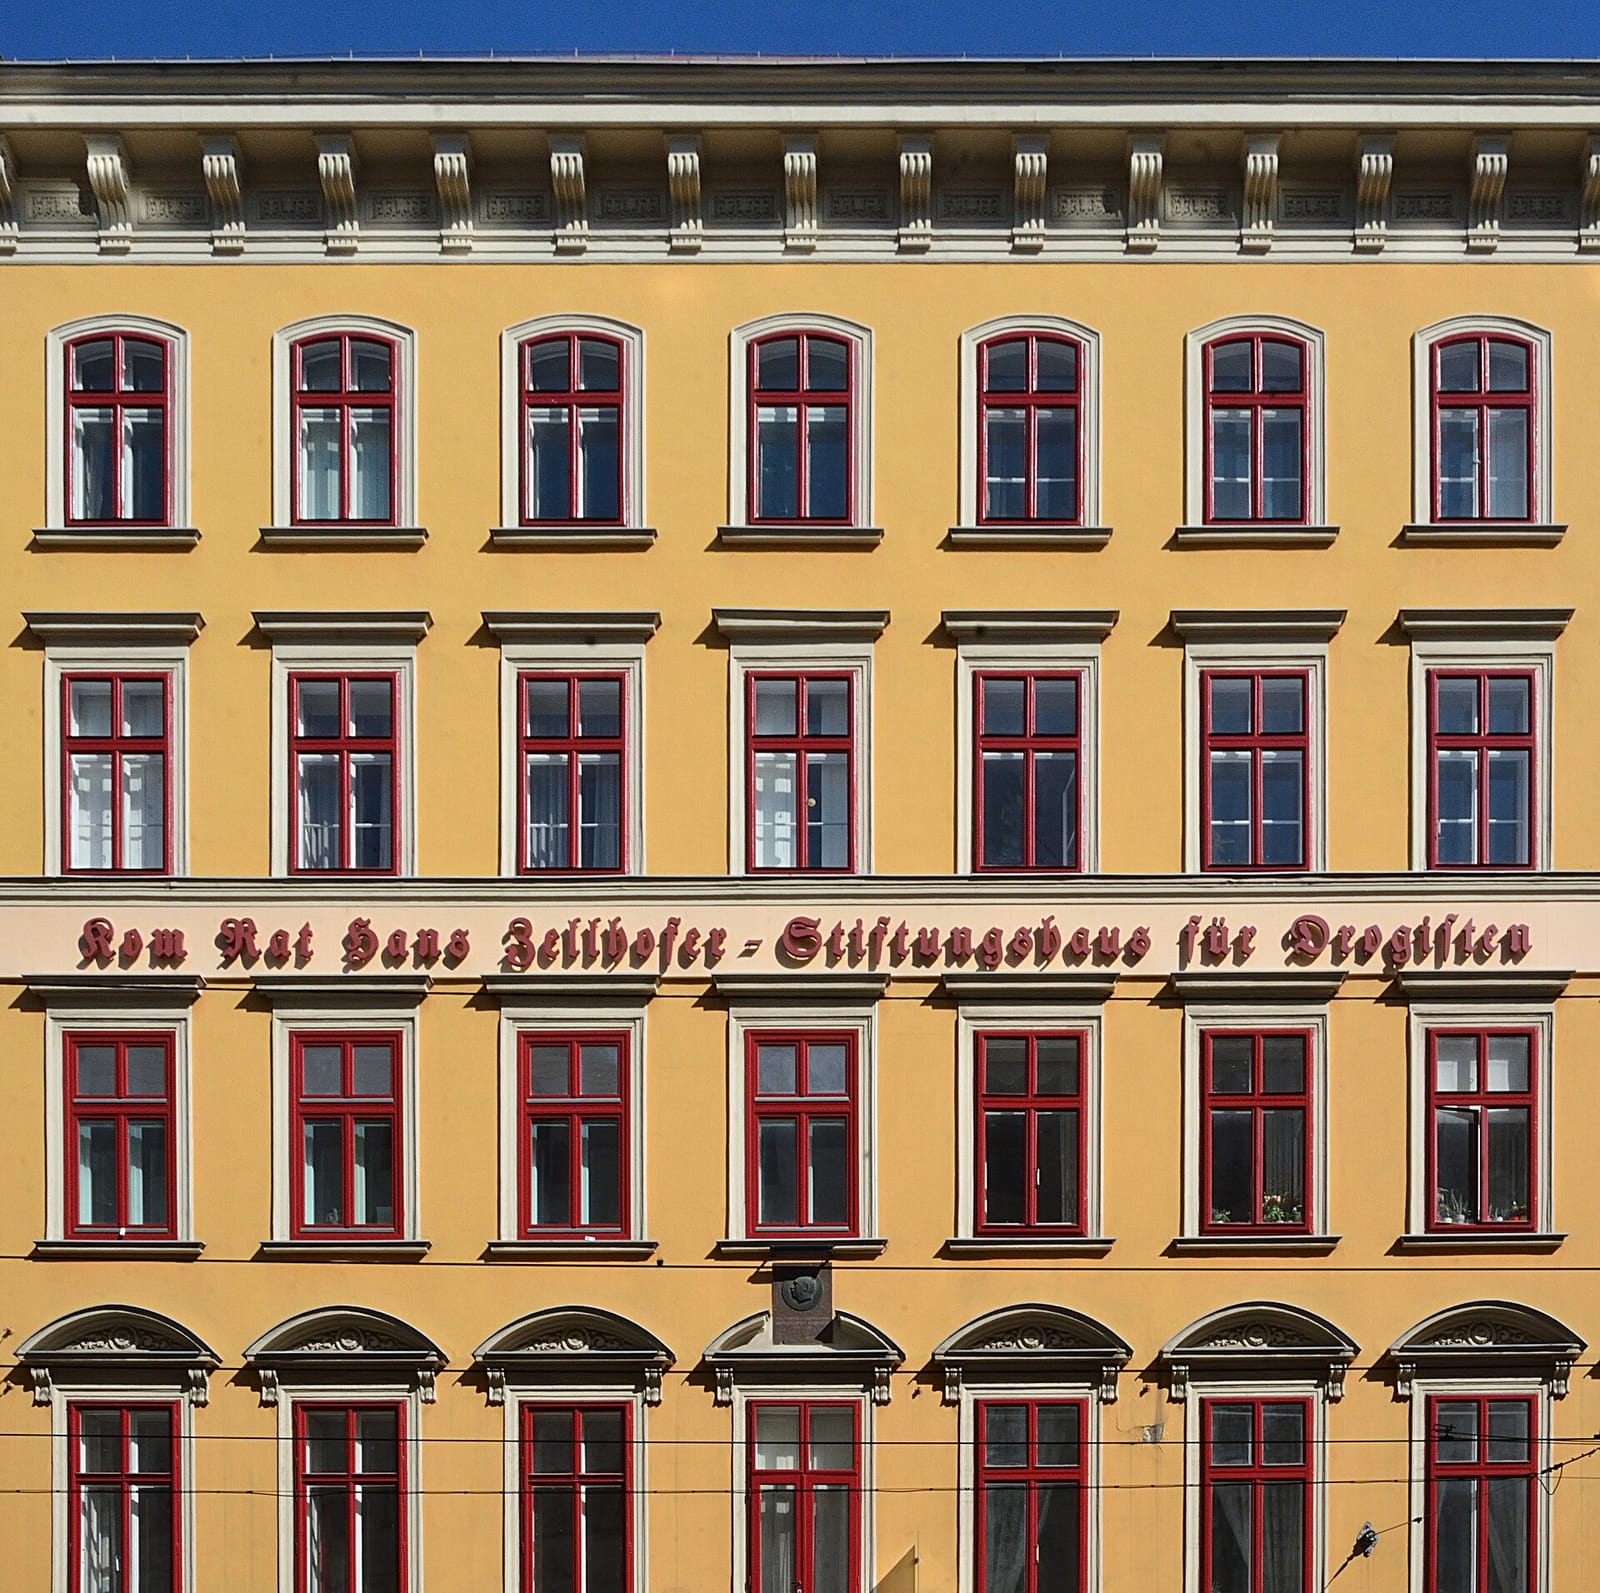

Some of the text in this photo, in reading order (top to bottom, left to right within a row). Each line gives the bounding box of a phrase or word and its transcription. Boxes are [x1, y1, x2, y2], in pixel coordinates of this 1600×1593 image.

[81, 917, 188, 961] Kom
[219, 917, 314, 960] Rat
[345, 916, 471, 964] Hans
[782, 914, 1153, 970] Stiftungshaus
[1183, 914, 1257, 962] für
